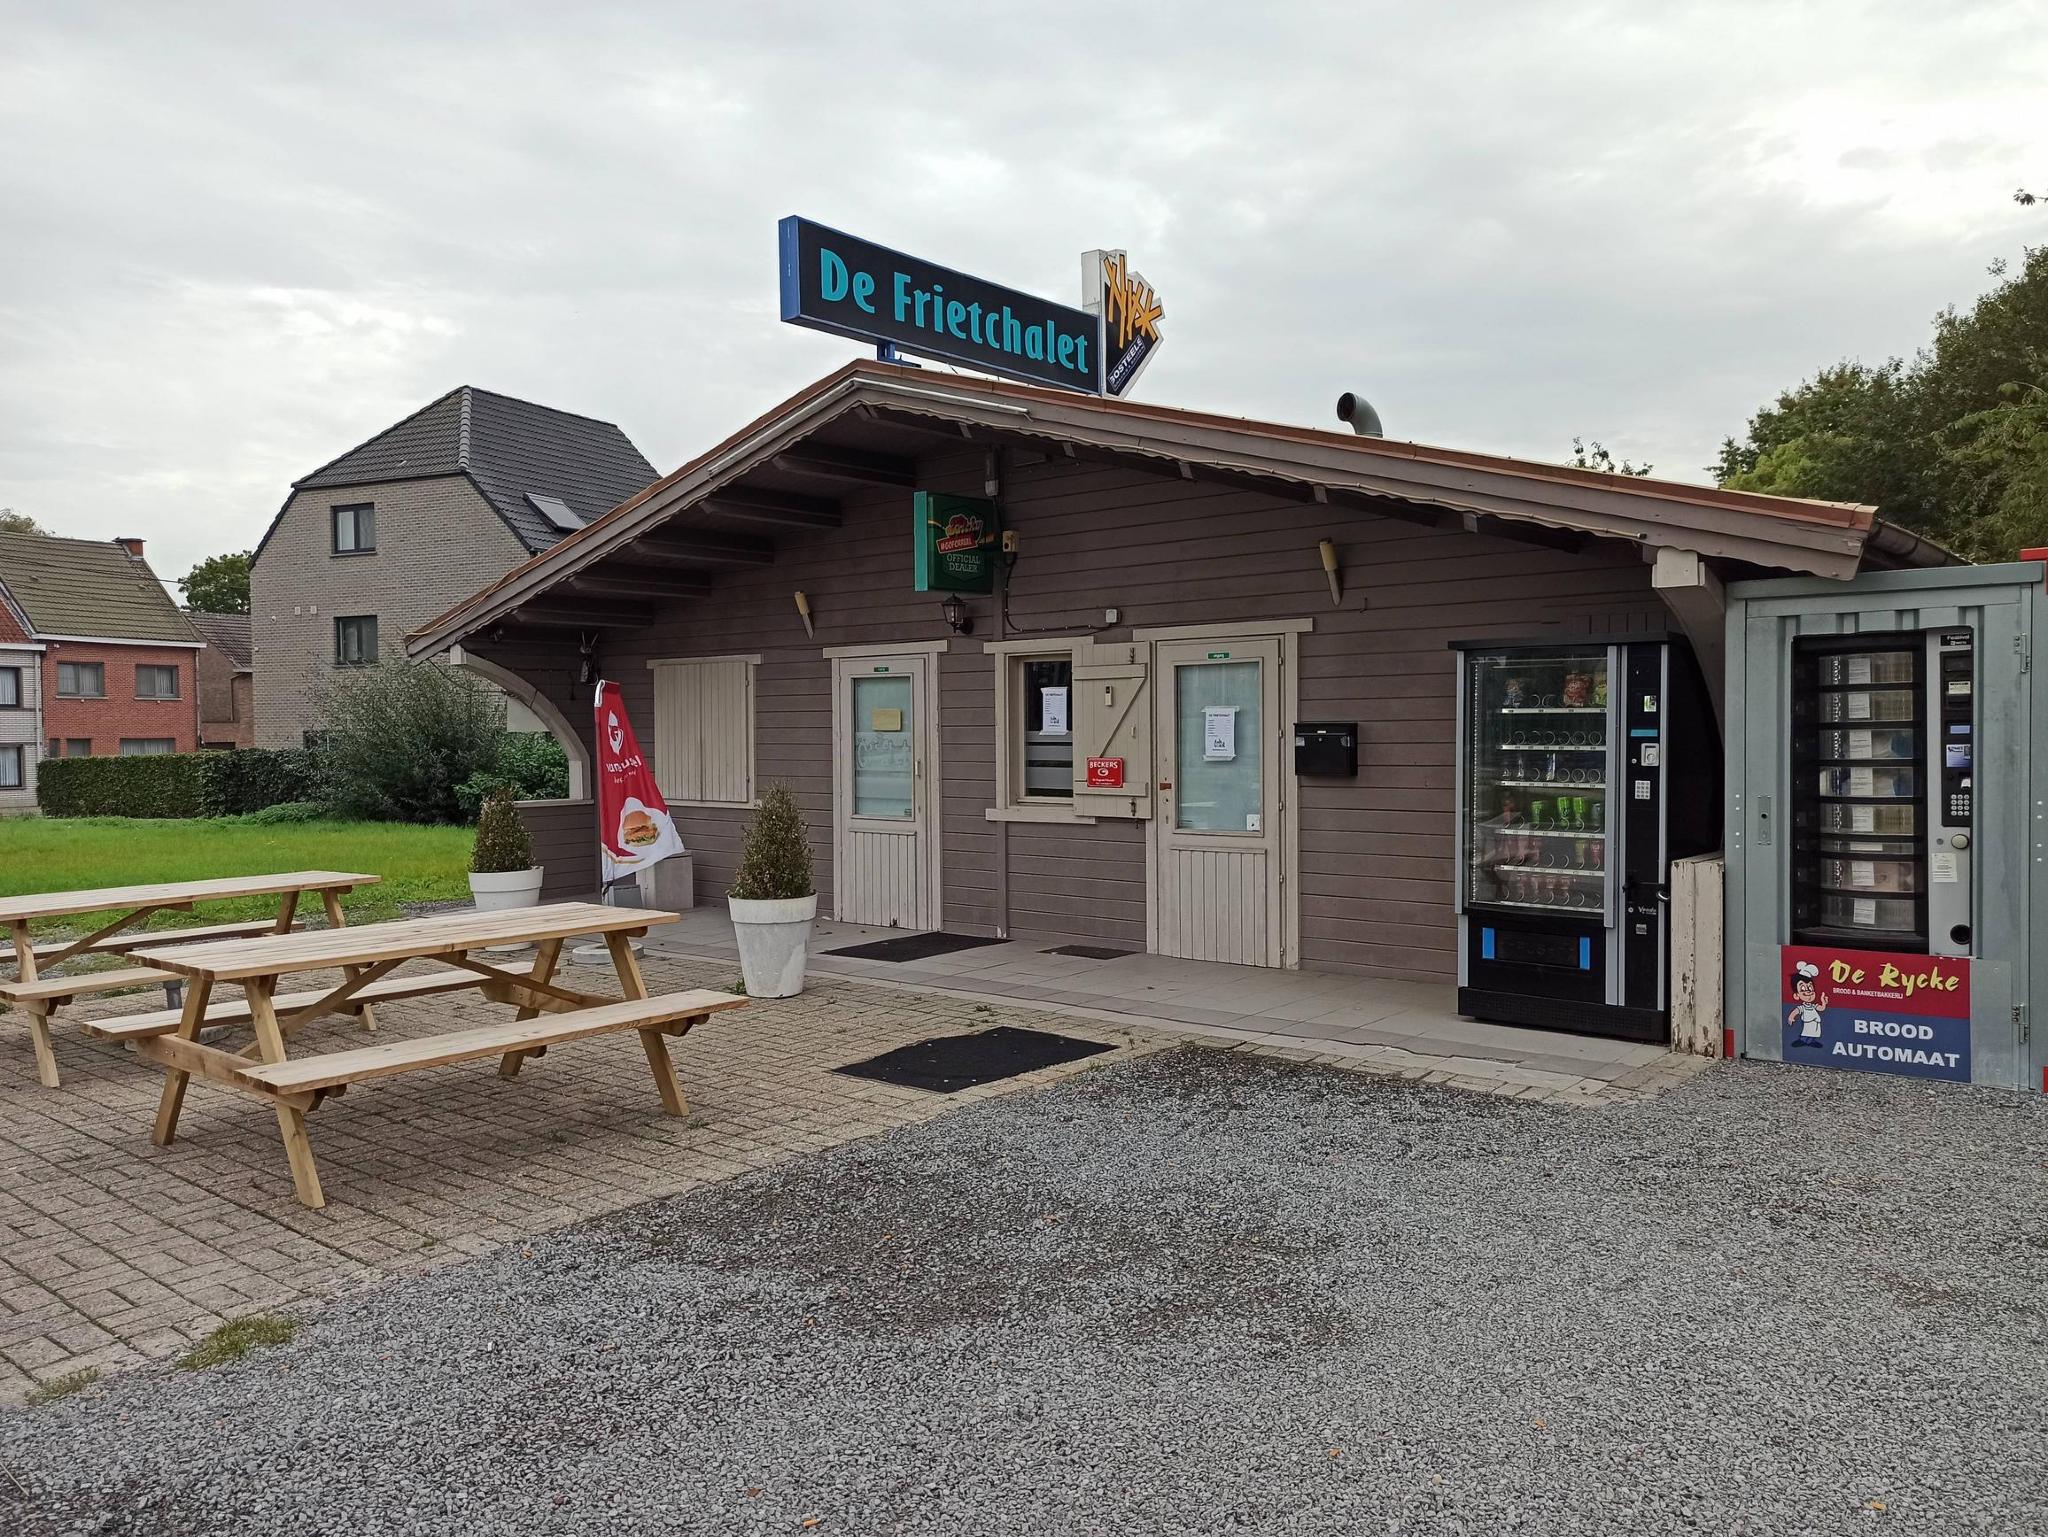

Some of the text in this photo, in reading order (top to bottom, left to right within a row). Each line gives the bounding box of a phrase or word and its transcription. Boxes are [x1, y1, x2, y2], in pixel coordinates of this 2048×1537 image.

[820, 247, 876, 314] De
[893, 271, 1089, 374] Frietchalet
[946, 553, 981, 565] OFFICIAL
[949, 562, 978, 573] DEALER
[1089, 761, 1118, 769] BECKERS
[1828, 959, 1960, 997] De Rycke
[1832, 987, 1851, 995] BROOD
[1857, 988, 1904, 999] BANKETBAKKERIJ
[1854, 1019, 1934, 1040] BROOD
[1832, 1041, 1960, 1068] AUTOMAAT
